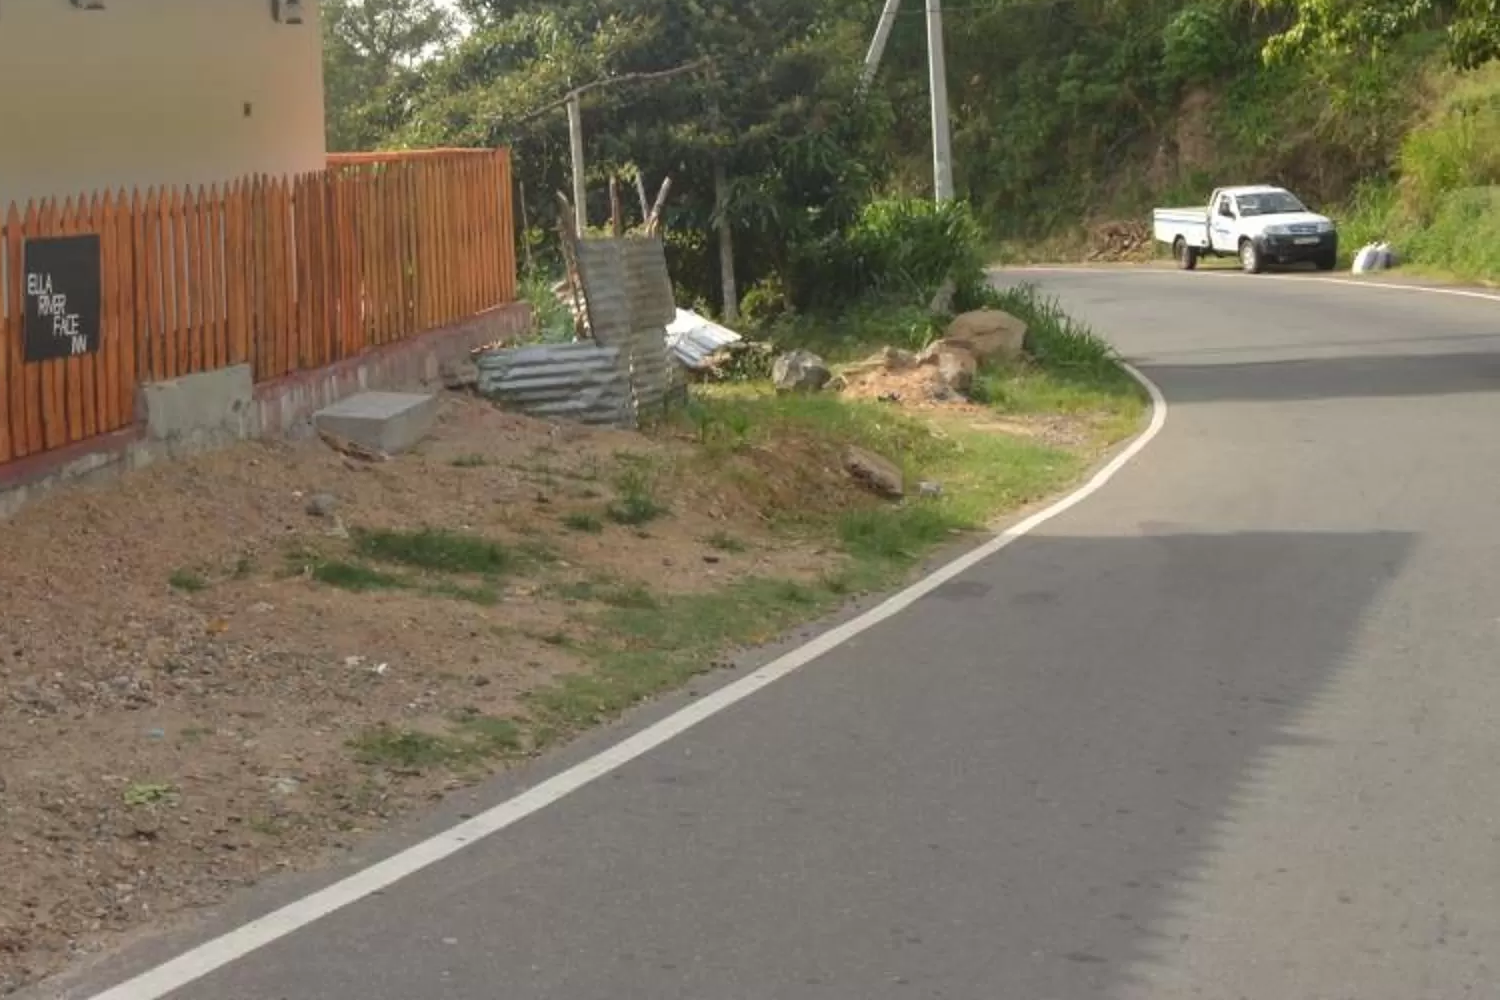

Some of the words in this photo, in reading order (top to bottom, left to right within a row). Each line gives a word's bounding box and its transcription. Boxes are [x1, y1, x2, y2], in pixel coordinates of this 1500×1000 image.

[27, 273, 53, 295] ELLA
[37, 294, 67, 316] RIVER
[53, 314, 80, 336] FACE
